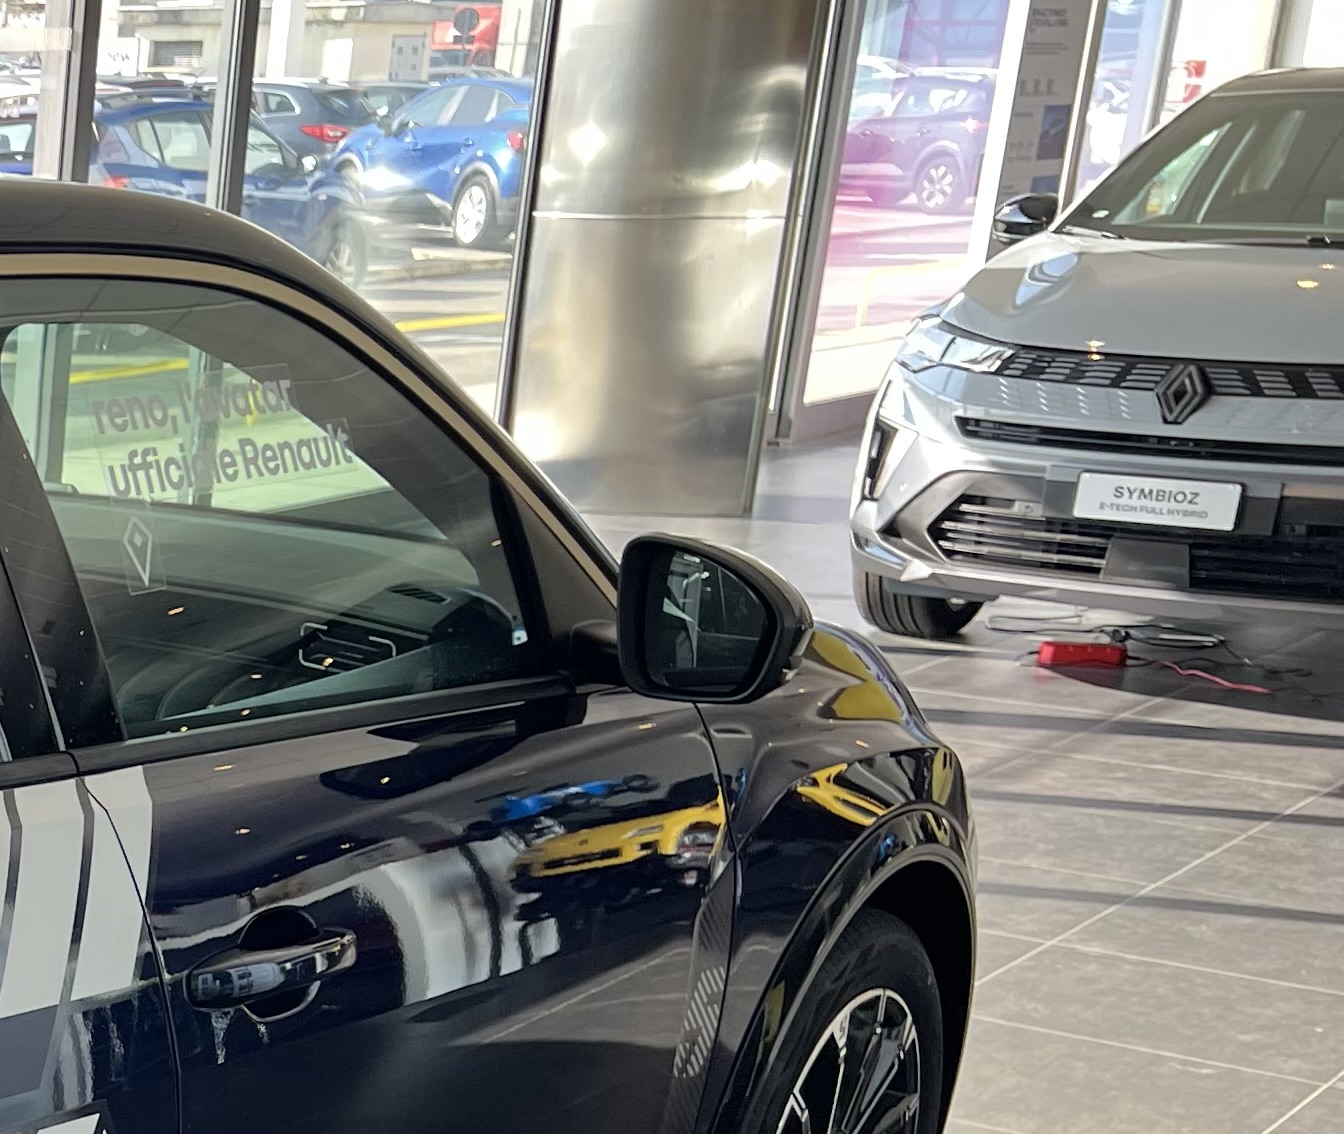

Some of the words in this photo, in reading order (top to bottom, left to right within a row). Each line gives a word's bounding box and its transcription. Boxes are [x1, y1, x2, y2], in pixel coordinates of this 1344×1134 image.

[92, 392, 179, 435] reno,
[237, 423, 354, 480] Renault
[1113, 485, 1201, 506] SYMBIOZ
